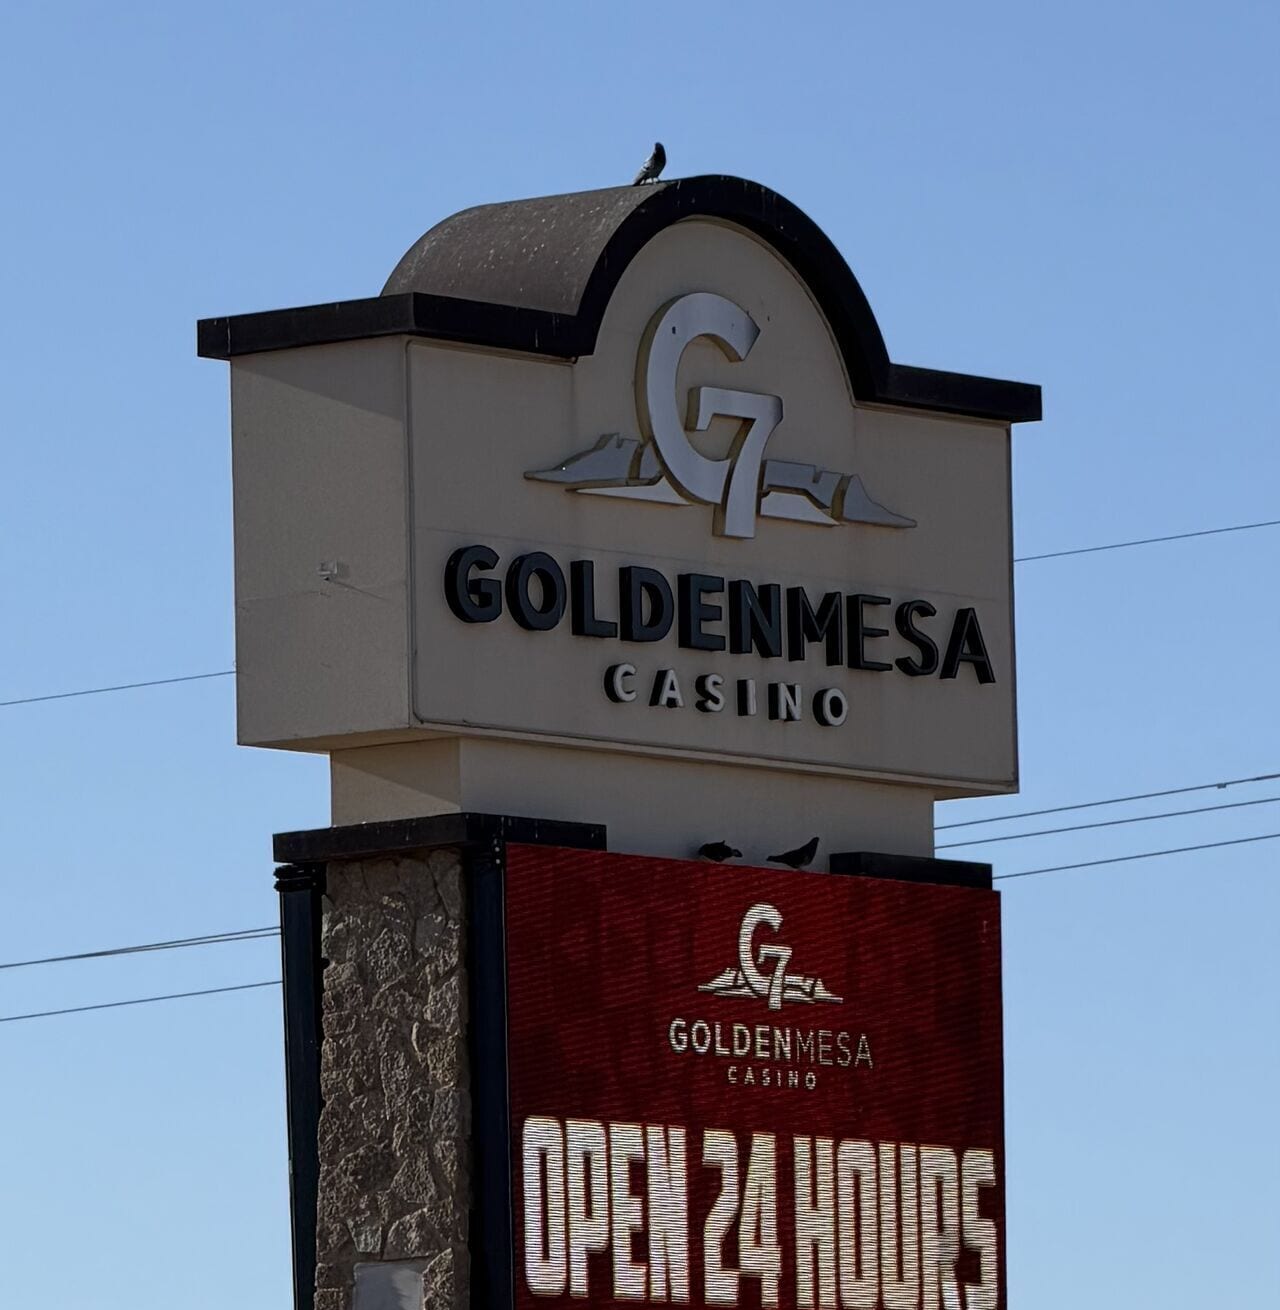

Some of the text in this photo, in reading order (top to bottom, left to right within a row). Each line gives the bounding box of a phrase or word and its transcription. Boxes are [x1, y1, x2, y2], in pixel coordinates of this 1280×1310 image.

[604, 663, 848, 727] CASINO
[728, 1066, 817, 1091] CASINO
[522, 1116, 690, 1303] OPEN
[702, 1128, 782, 1310] 24
